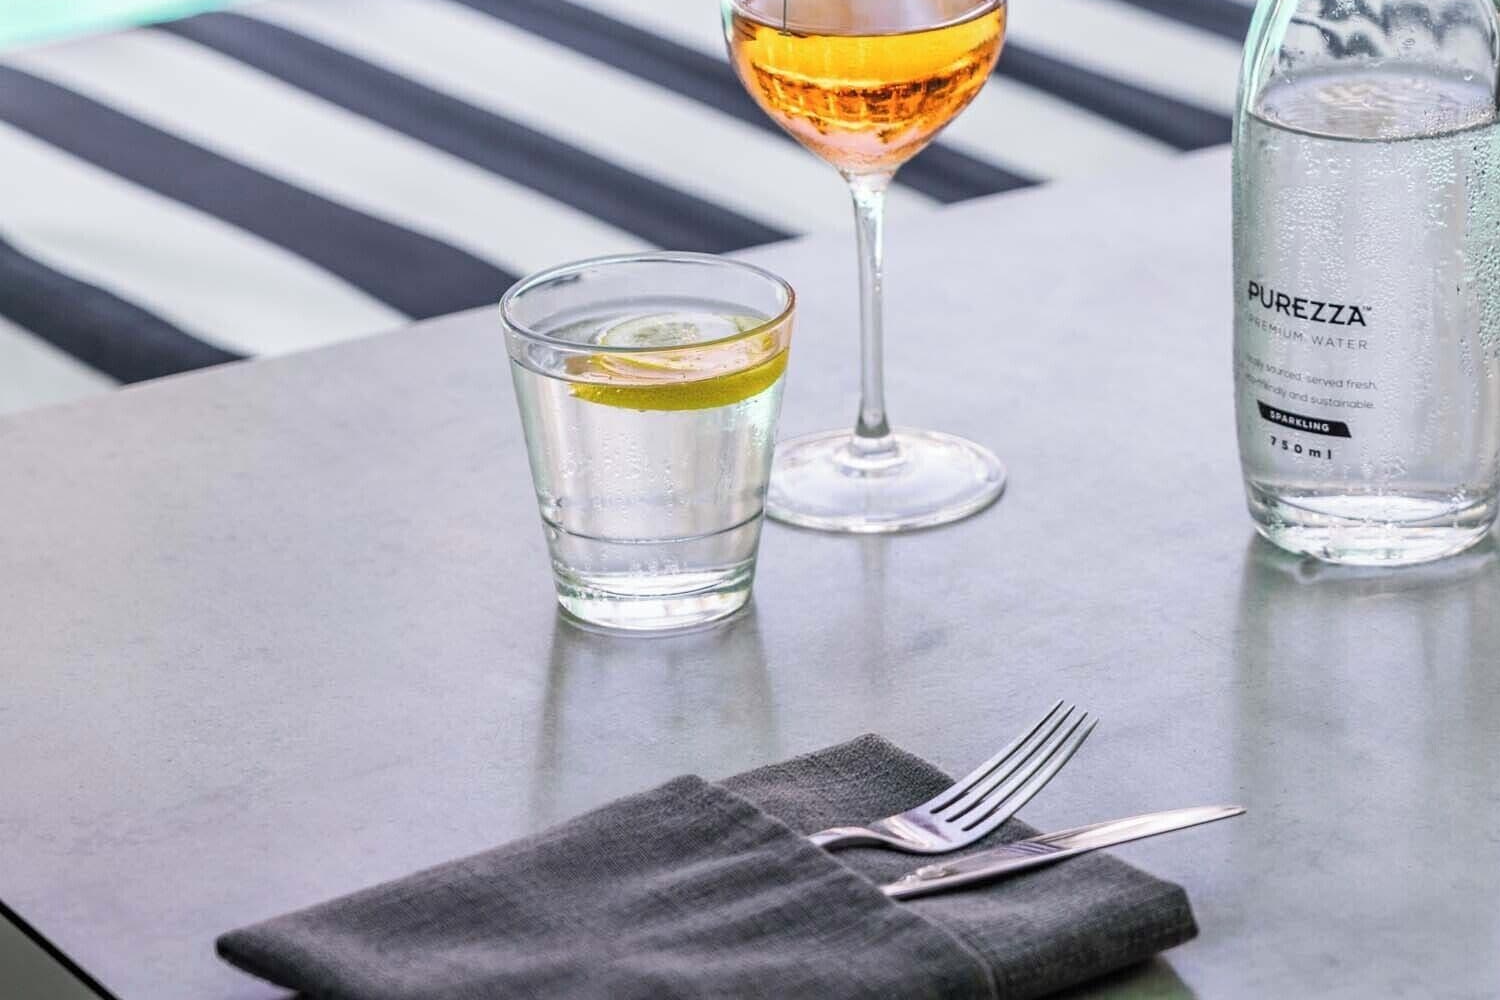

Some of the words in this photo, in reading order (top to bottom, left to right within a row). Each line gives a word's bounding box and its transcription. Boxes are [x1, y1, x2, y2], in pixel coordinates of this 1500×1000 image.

[1248, 313, 1303, 342] PREMIUM
[1311, 335, 1368, 350] WATER
[1306, 375, 1343, 388] served
[1288, 391, 1308, 403] and
[1270, 410, 1329, 432] SPARKLING
[1270, 435, 1332, 460] 750ml
